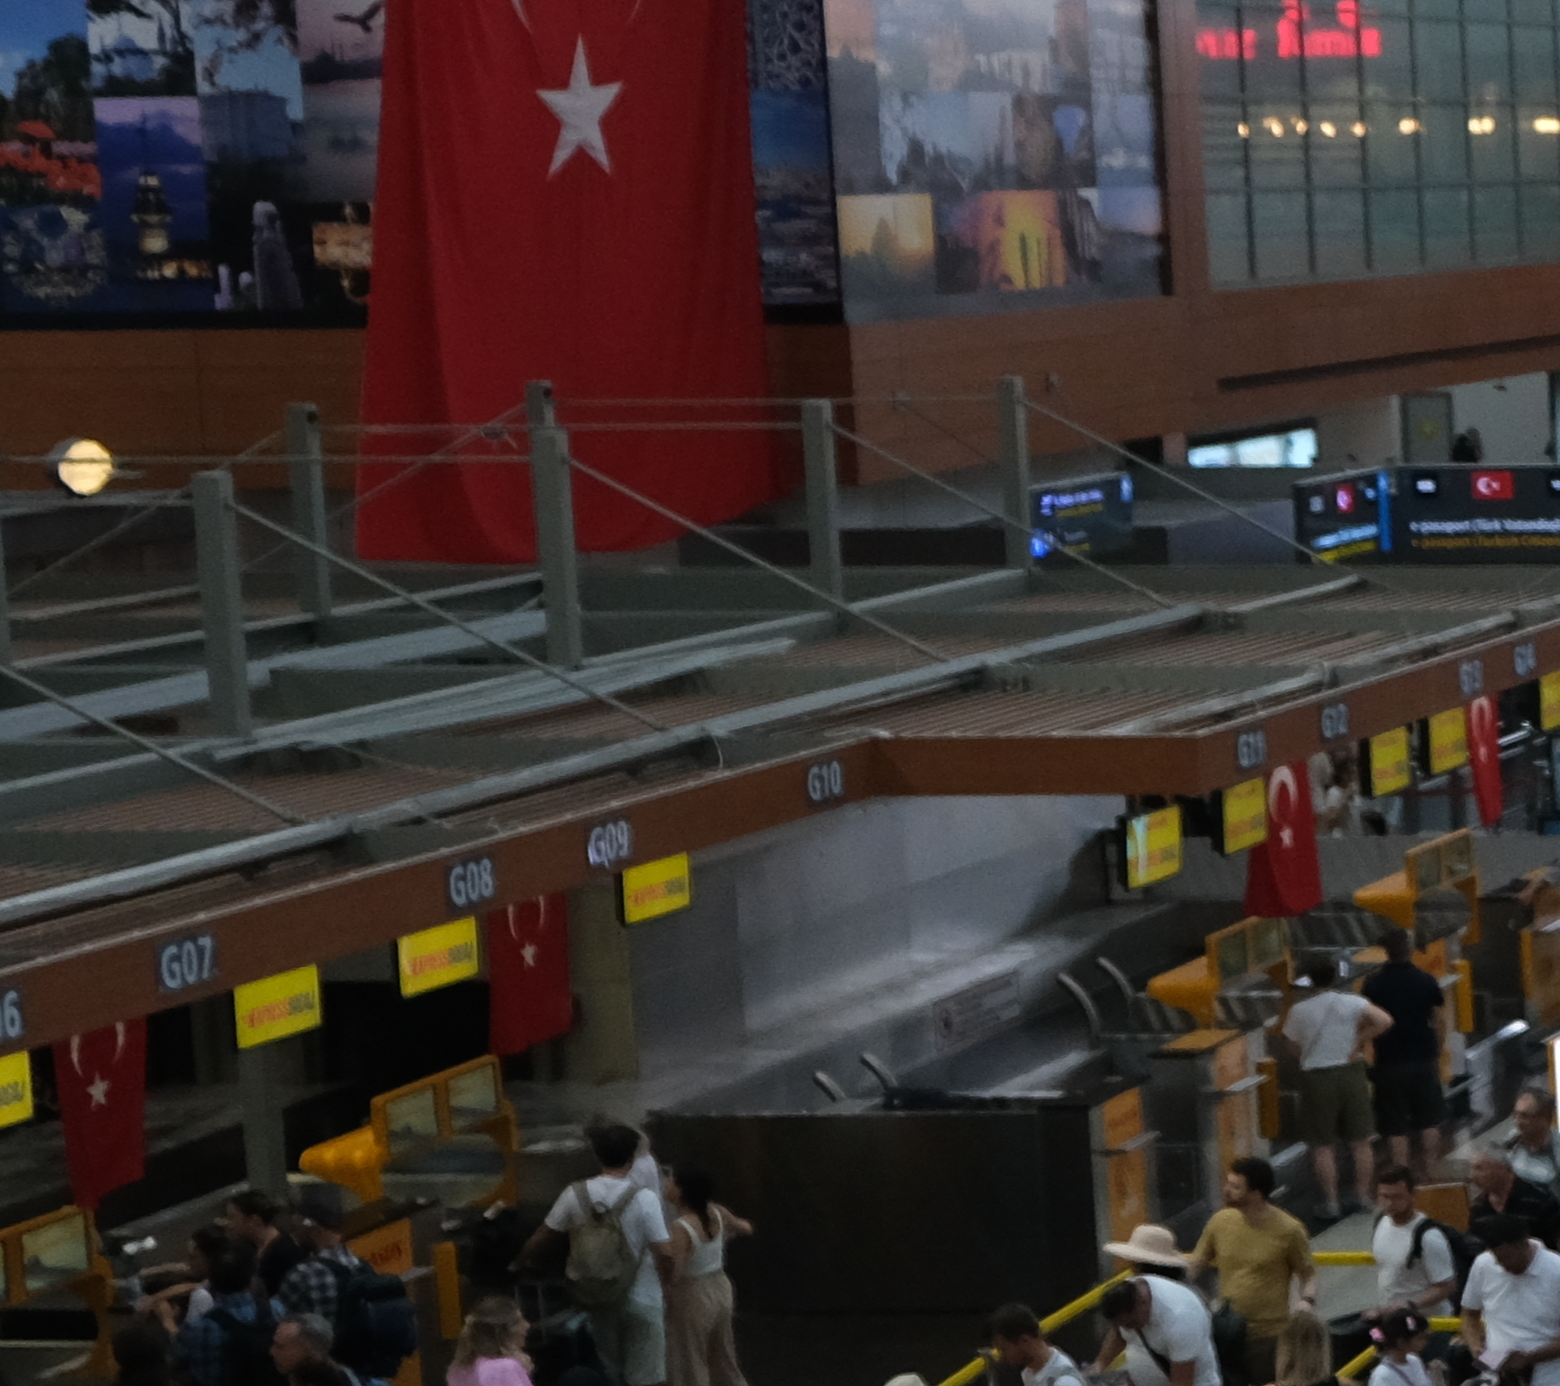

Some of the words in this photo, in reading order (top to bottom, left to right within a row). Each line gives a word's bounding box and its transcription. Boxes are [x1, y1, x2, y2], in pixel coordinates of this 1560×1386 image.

[808, 763, 841, 800] G10
[587, 819, 631, 867] G09
[449, 859, 494, 907] G08
[160, 937, 213, 991] G07
